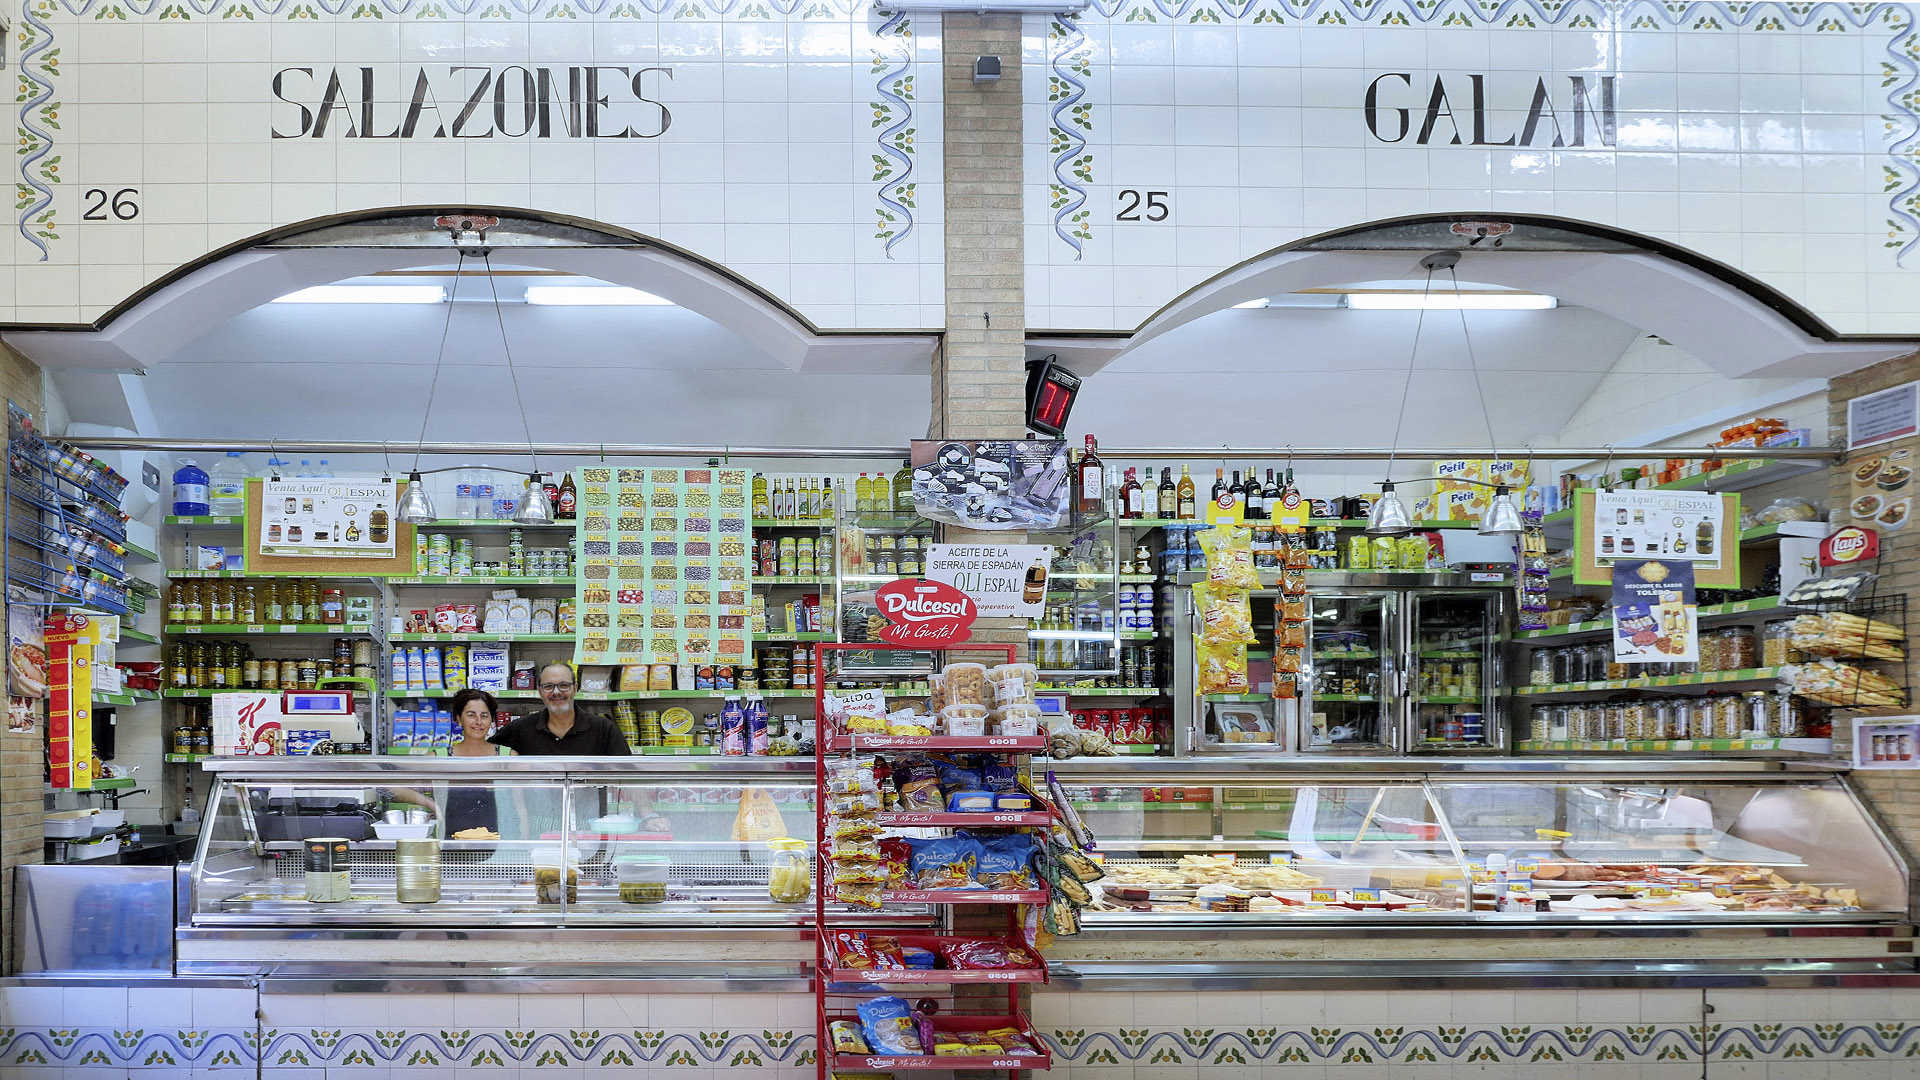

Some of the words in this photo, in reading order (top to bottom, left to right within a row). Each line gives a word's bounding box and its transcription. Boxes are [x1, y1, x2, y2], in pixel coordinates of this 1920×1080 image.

[271, 65, 673, 139] SALAZONES
[1364, 72, 1617, 147] GALAN
[83, 188, 140, 221] 26
[1115, 189, 1170, 222] 25
[1439, 461, 1466, 475] Petit
[1490, 461, 1514, 474] Petit
[1451, 491, 1475, 503] Petit
[947, 548, 981, 557] ACEITE
[982, 548, 995, 557] DE
[997, 548, 1009, 557] LA
[932, 560, 965, 570] SIERRA
[967, 561, 980, 570] DE
[982, 559, 1024, 570] ESPADÁN
[953, 571, 982, 593] OLI
[984, 577, 1020, 593] ESPAL
[883, 592, 968, 617] Dulcesol
[890, 623, 912, 640] Me
[914, 623, 960, 640] Gusta!
[238, 697, 267, 729] K
[889, 864, 903, 875] 1€
[951, 864, 967, 875] 1€
